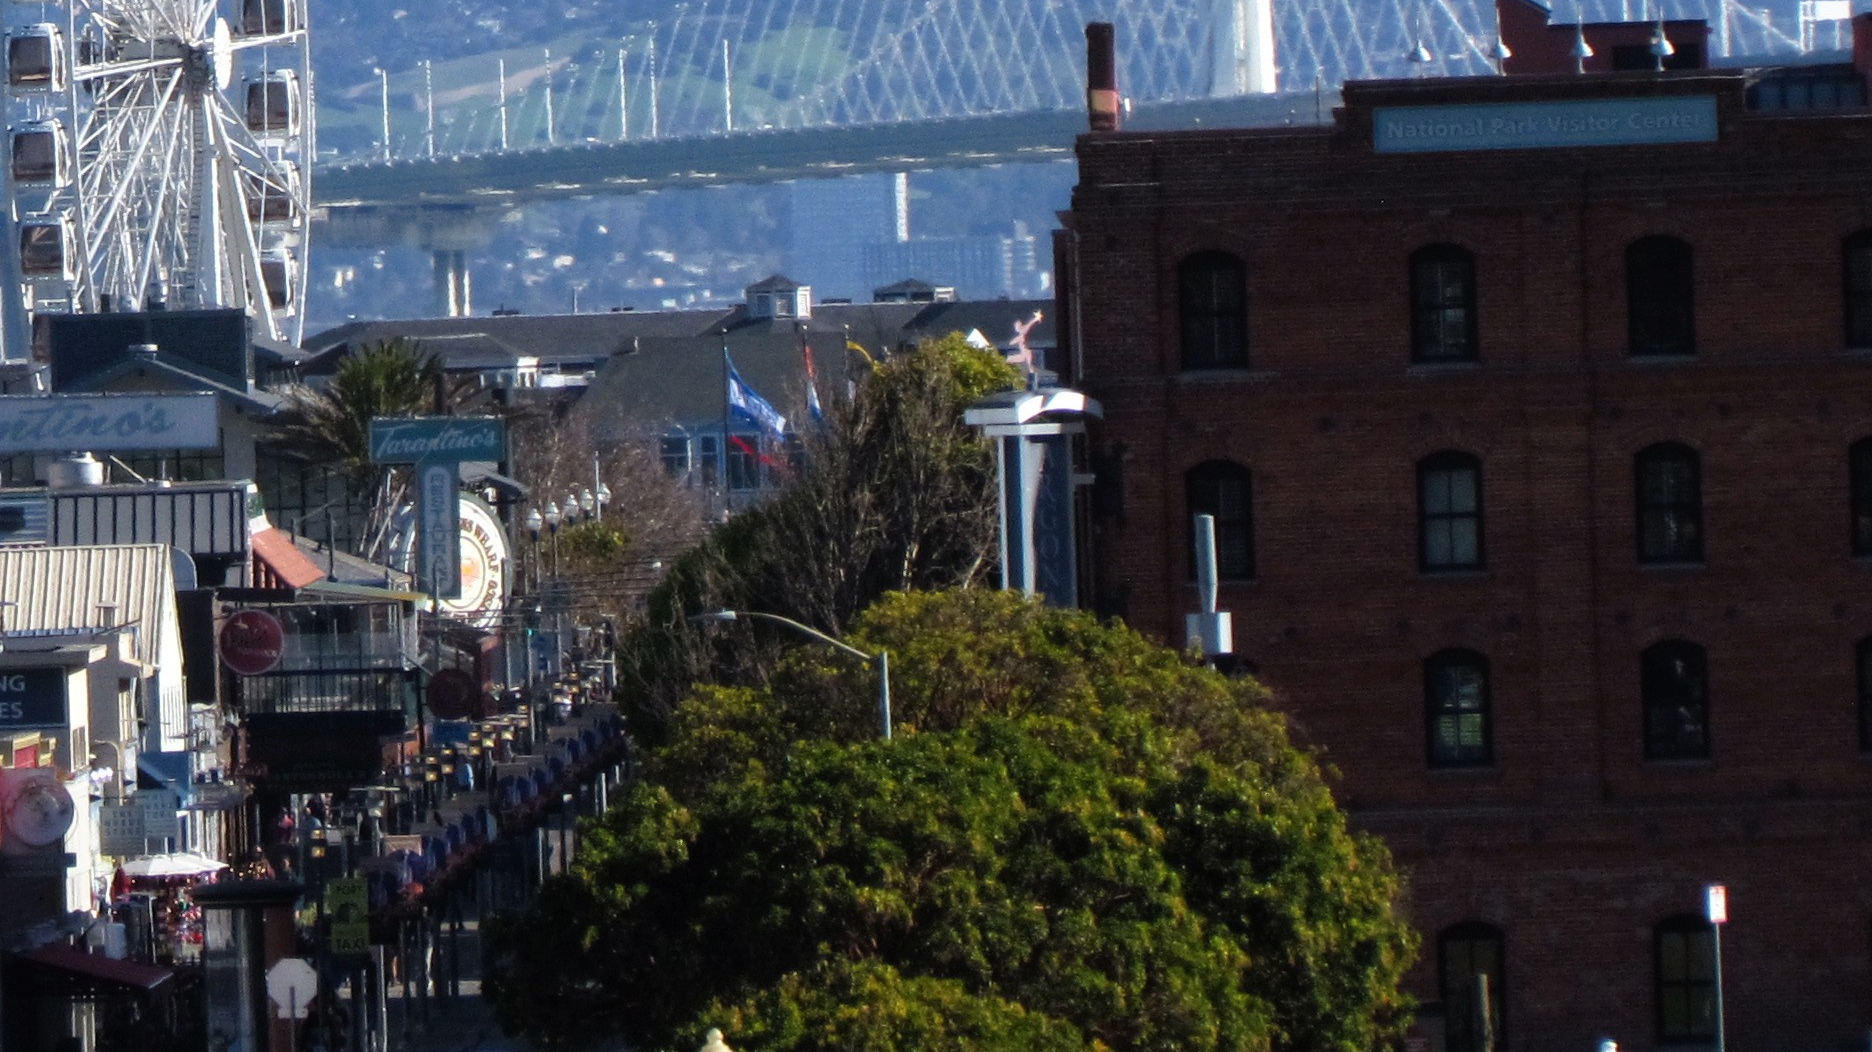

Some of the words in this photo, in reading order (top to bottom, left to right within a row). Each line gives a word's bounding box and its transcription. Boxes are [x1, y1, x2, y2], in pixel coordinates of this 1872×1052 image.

[1387, 119, 1483, 139] National
[1491, 116, 1538, 135] Park
[1546, 113, 1619, 133] Visitor
[1627, 112, 1699, 130] Center
[373, 423, 497, 459] Tarantino's
[474, 523, 500, 573] WHARF
